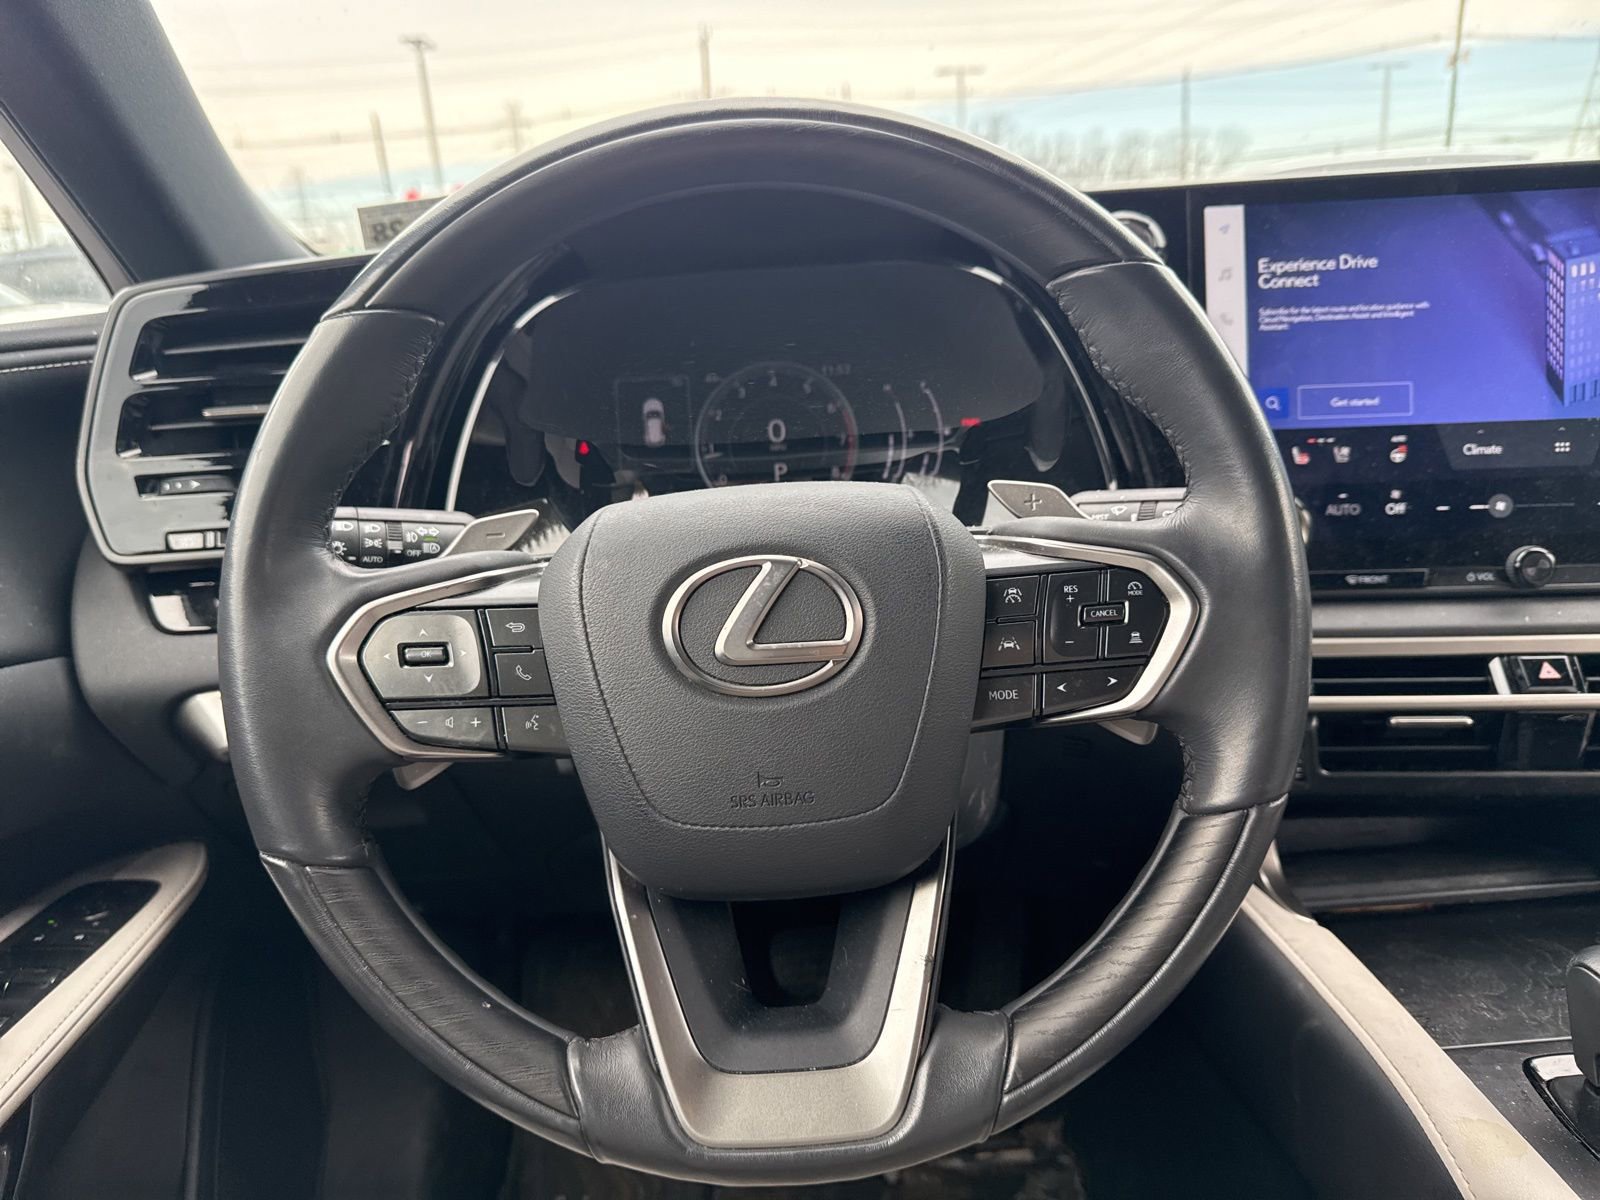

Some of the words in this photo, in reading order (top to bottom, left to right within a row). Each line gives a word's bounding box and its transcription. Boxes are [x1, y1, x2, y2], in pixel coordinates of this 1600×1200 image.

[1258, 257, 1336, 275] Experience
[1339, 253, 1378, 270] Drive
[1258, 274, 1319, 290] Connect
[768, 418, 786, 443] 0
[1463, 443, 1503, 456] Climate
[774, 462, 788, 482] P
[1325, 503, 1361, 516] AUTO
[406, 548, 422, 557] OFF
[362, 555, 384, 563] AUTO
[1476, 571, 1495, 582] VOL
[1063, 585, 1078, 593] RES
[1090, 609, 1118, 617] CANCEL
[421, 650, 432, 658] OK
[988, 690, 1019, 701] MODE
[730, 794, 757, 809] SRS
[760, 791, 816, 808] AIRBAG
